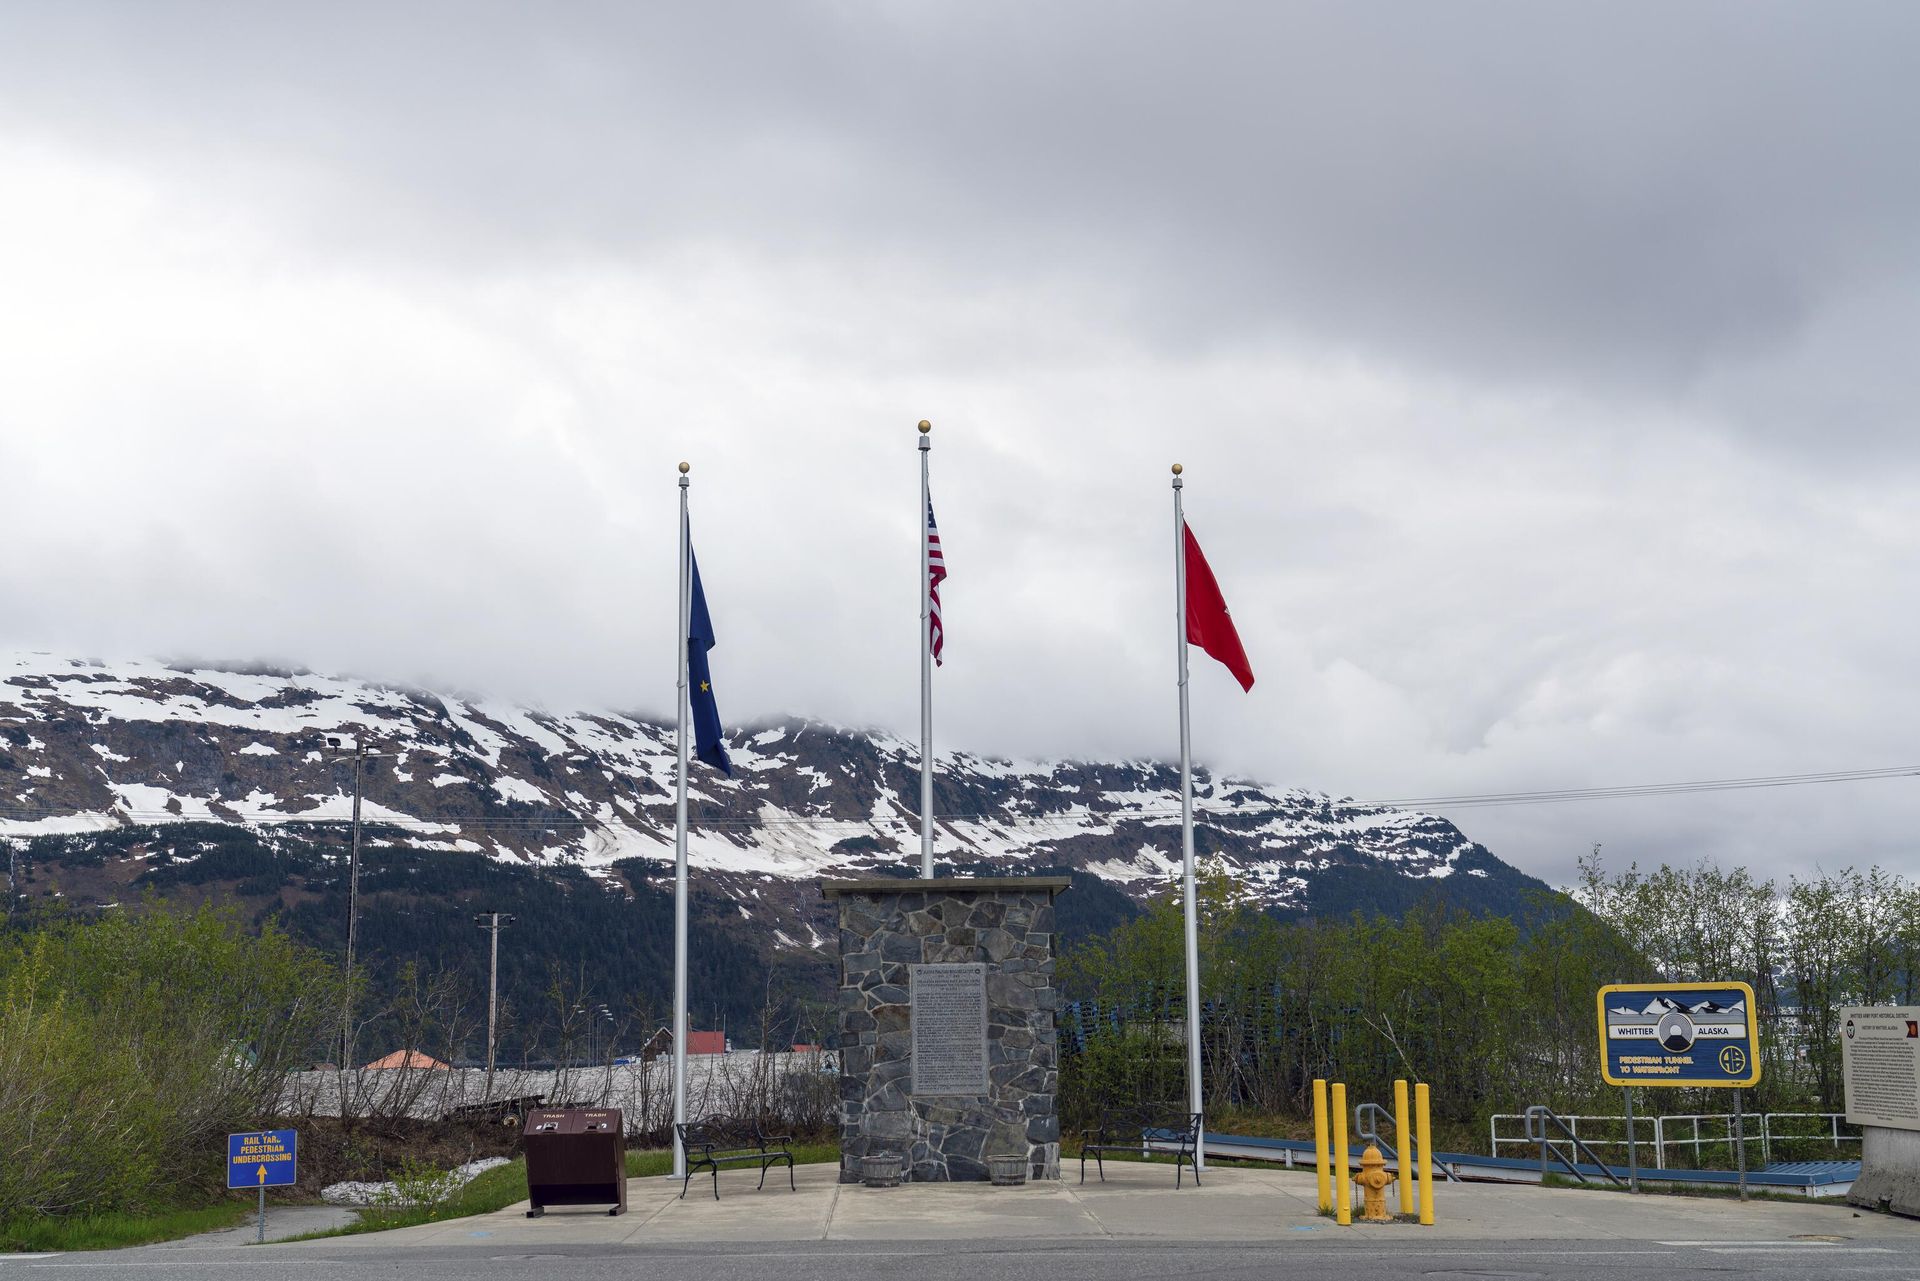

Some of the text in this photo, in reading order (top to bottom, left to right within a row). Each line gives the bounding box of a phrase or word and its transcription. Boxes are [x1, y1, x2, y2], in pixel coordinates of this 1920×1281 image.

[1620, 1066, 1630, 1074] TO
[244, 1136, 260, 1144] RAIL
[240, 1144, 284, 1154] PEDESTRIAN
[233, 1153, 292, 1164] UNDERCROSSING
